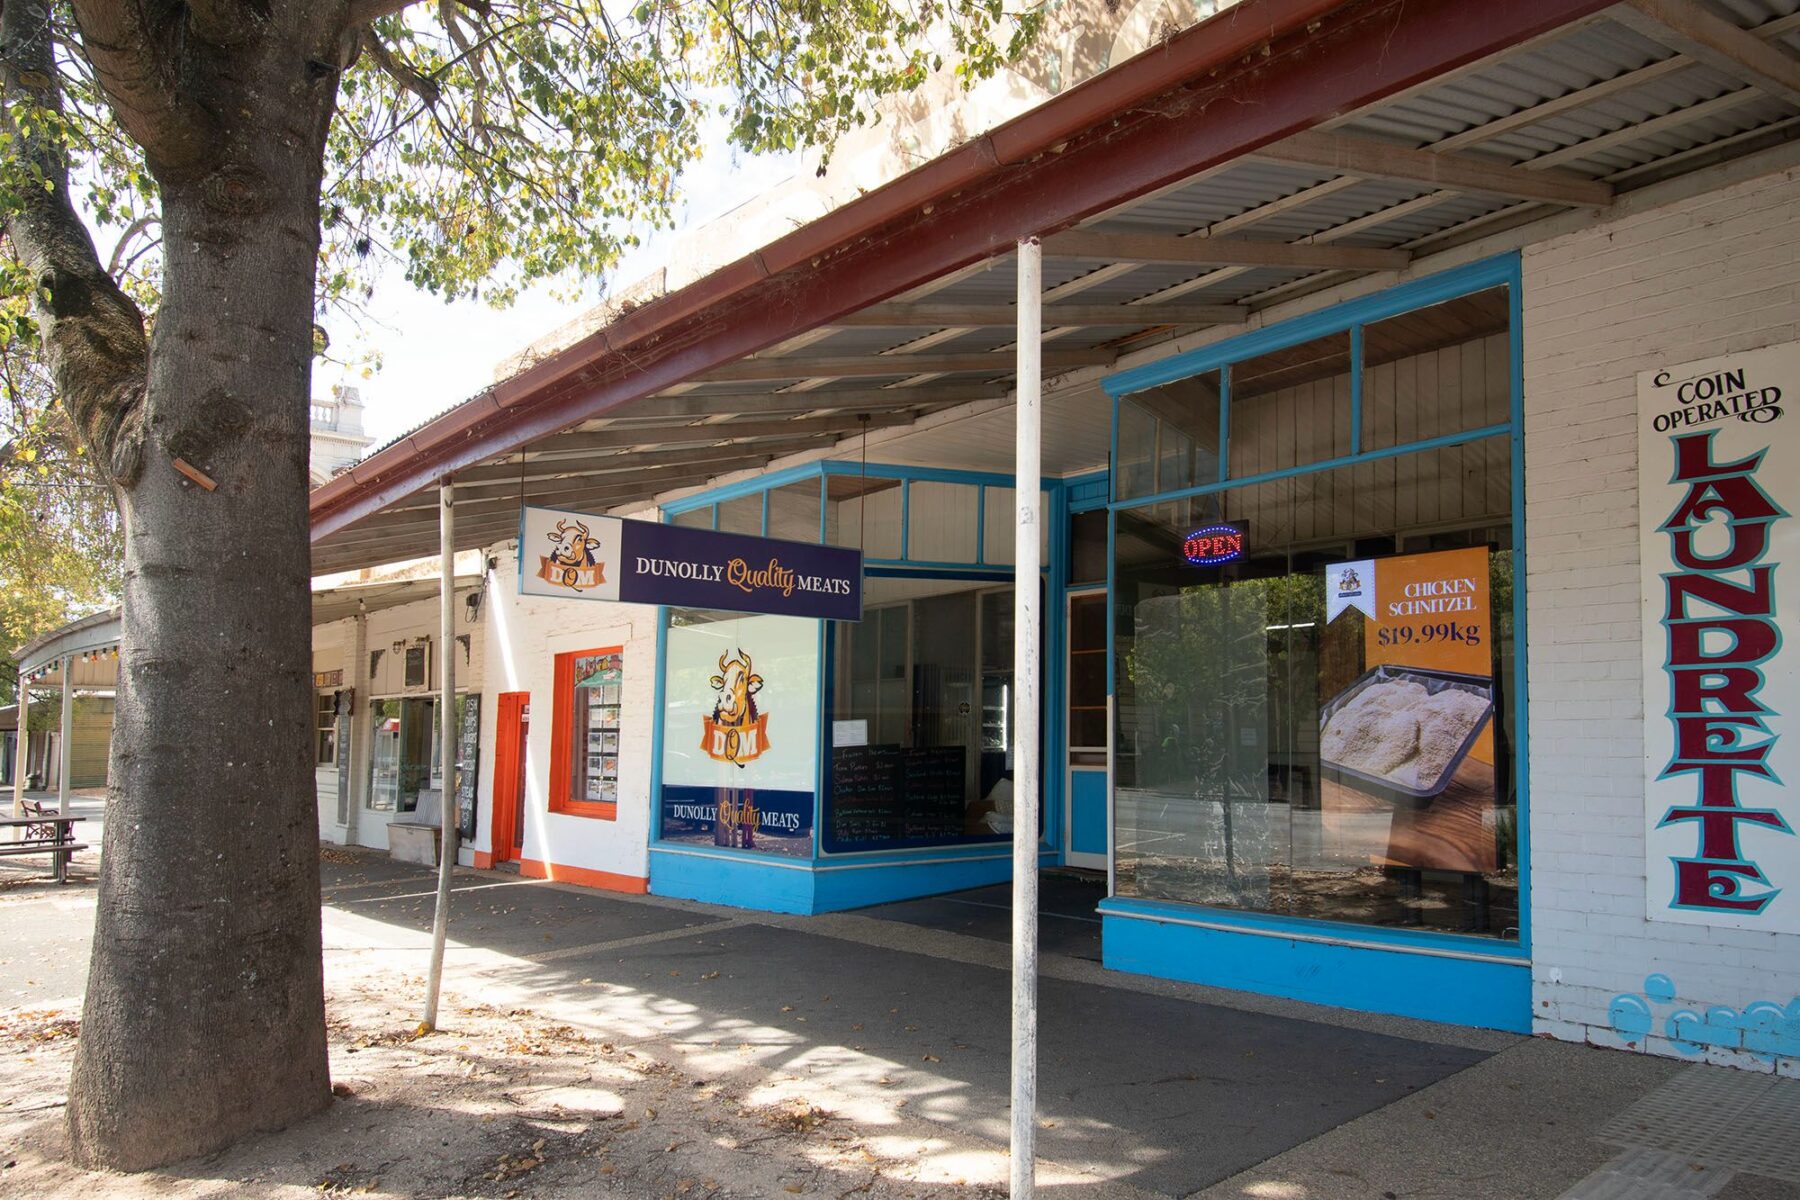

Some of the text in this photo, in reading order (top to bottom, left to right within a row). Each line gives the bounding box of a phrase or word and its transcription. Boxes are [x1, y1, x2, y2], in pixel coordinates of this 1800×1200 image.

[1677, 368, 1746, 405] COIN
[1653, 386, 1782, 433] OPERATED
[1183, 534, 1242, 558] OPEN
[551, 566, 596, 593] DQM
[635, 557, 850, 597] DUNOLLY Quality MEATS
[1404, 577, 1476, 598] CHICKEN
[1388, 596, 1477, 617] SCHNITZEL
[1378, 621, 1480, 647] $19.99kg
[1655, 427, 1798, 916] LAUNDRETTE
[713, 728, 758, 769] DQM
[673, 798, 800, 833] DUNOLLY Quality MEATS
